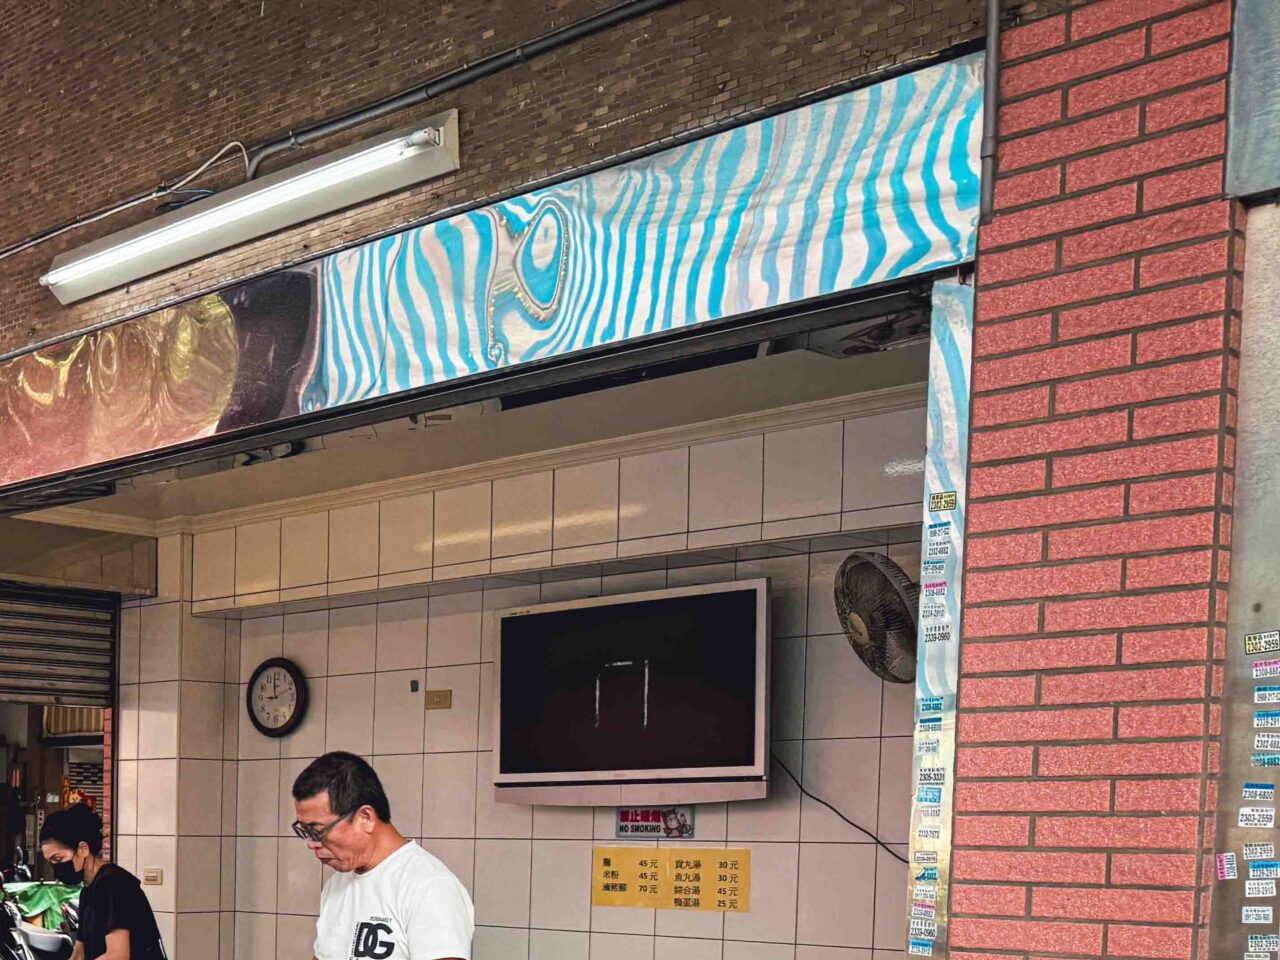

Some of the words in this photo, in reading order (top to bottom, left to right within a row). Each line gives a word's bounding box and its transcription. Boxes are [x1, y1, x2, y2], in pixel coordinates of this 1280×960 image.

[1247, 638, 1279, 653] 2302-2959
[1239, 813, 1273, 823] 2303-2559
[619, 824, 629, 833] NO
[630, 824, 661, 833] SMOKING
[354, 922, 395, 960] DG
